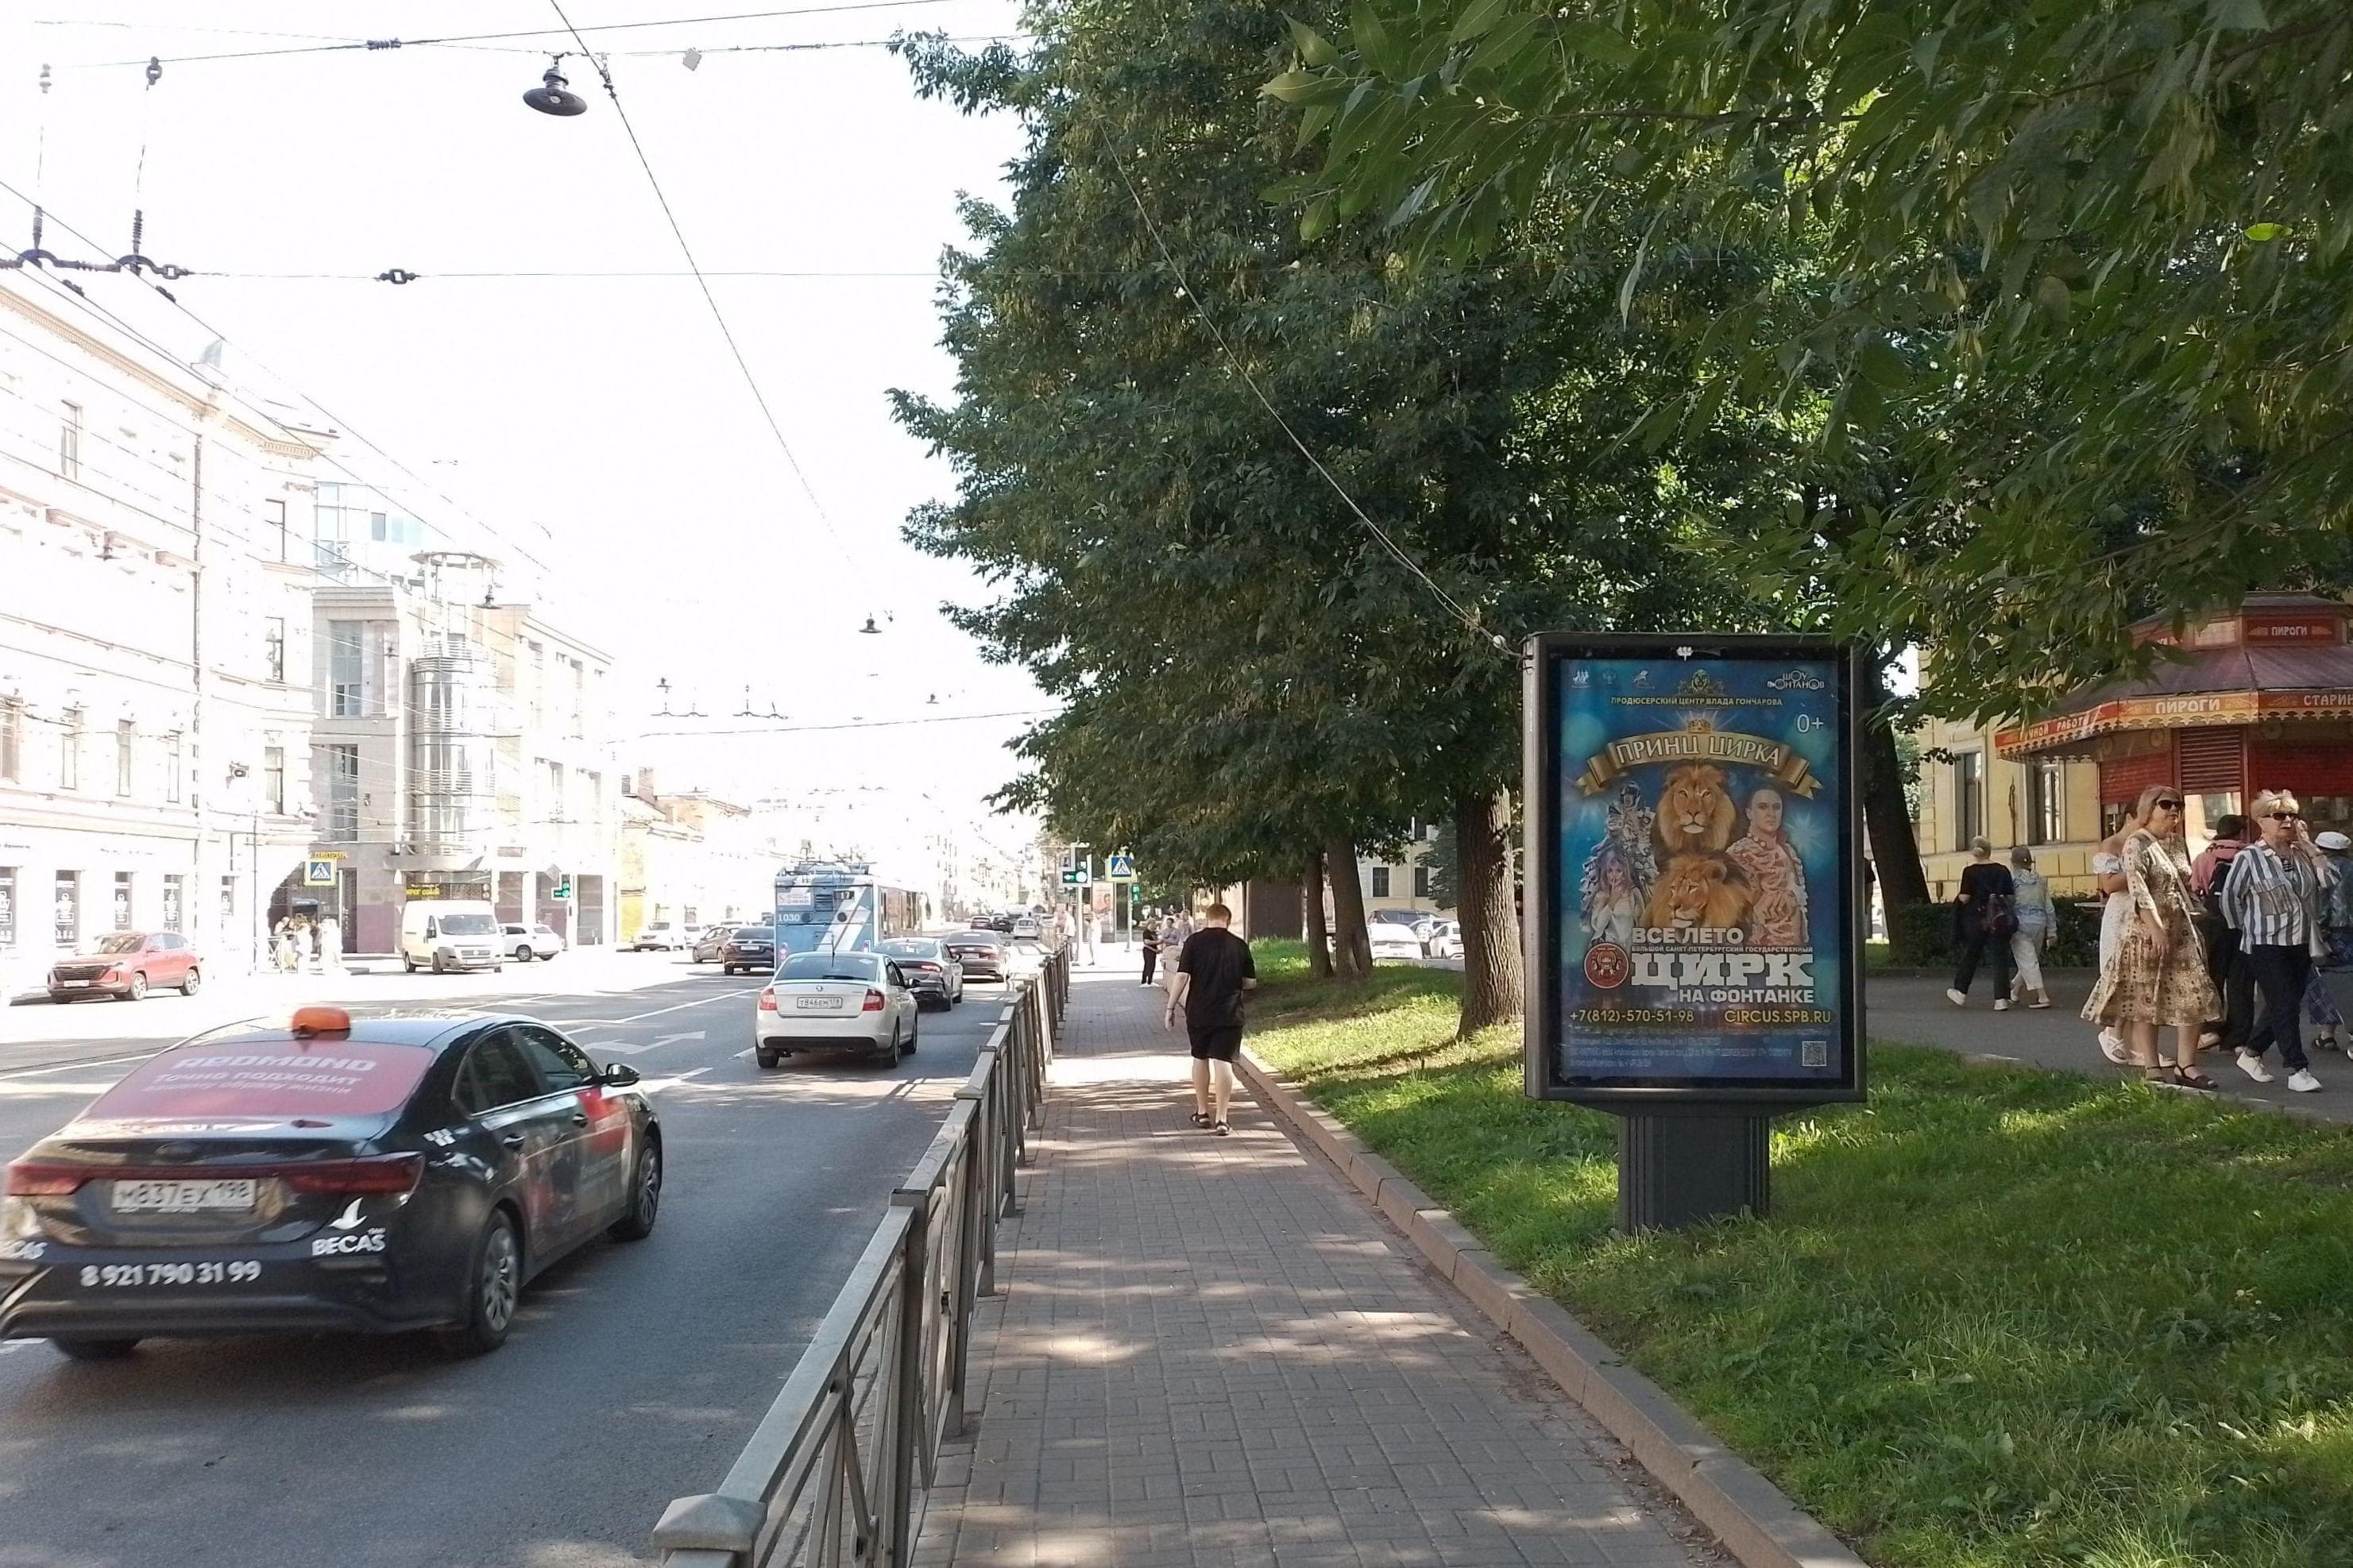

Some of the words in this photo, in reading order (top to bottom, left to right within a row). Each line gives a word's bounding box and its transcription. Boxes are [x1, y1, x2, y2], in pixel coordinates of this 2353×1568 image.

[2271, 626, 2307, 636] ПИРОГИ
[1783, 670, 1808, 681] ШОУ
[1611, 696, 1678, 706] ПРОДЮСЕРСКИЙ
[1679, 697, 1705, 705] ЦЕНТР
[1706, 697, 1734, 706] ВЛАДА
[1735, 697, 1783, 706] ГОНЧАРОВА
[2155, 698, 2220, 714] ПИРОГИ
[1796, 714, 1825, 733] 0+
[1616, 736, 1699, 764] ПРИНЦ
[1709, 736, 1780, 767] ЦИРКА
[1632, 927, 1675, 944] ВСЕ
[1683, 927, 1744, 944] ЛЕТО
[1631, 952, 1814, 991] ЦИРК
[1679, 989, 1704, 1003] НА
[1710, 989, 1814, 1003] ФОНТАНКЕ
[1725, 1010, 1831, 1023] CIRCUS.SPB.RU
[171, 1056, 377, 1072] REDMOND
[233, 1072, 362, 1085] подходит
[311, 1234, 386, 1256] BECAS
[80, 1265, 99, 1287] 8
[100, 1265, 144, 1287] 921
[149, 1262, 194, 1284] 790
[197, 1261, 224, 1284] 31
[228, 1260, 262, 1284] 99
